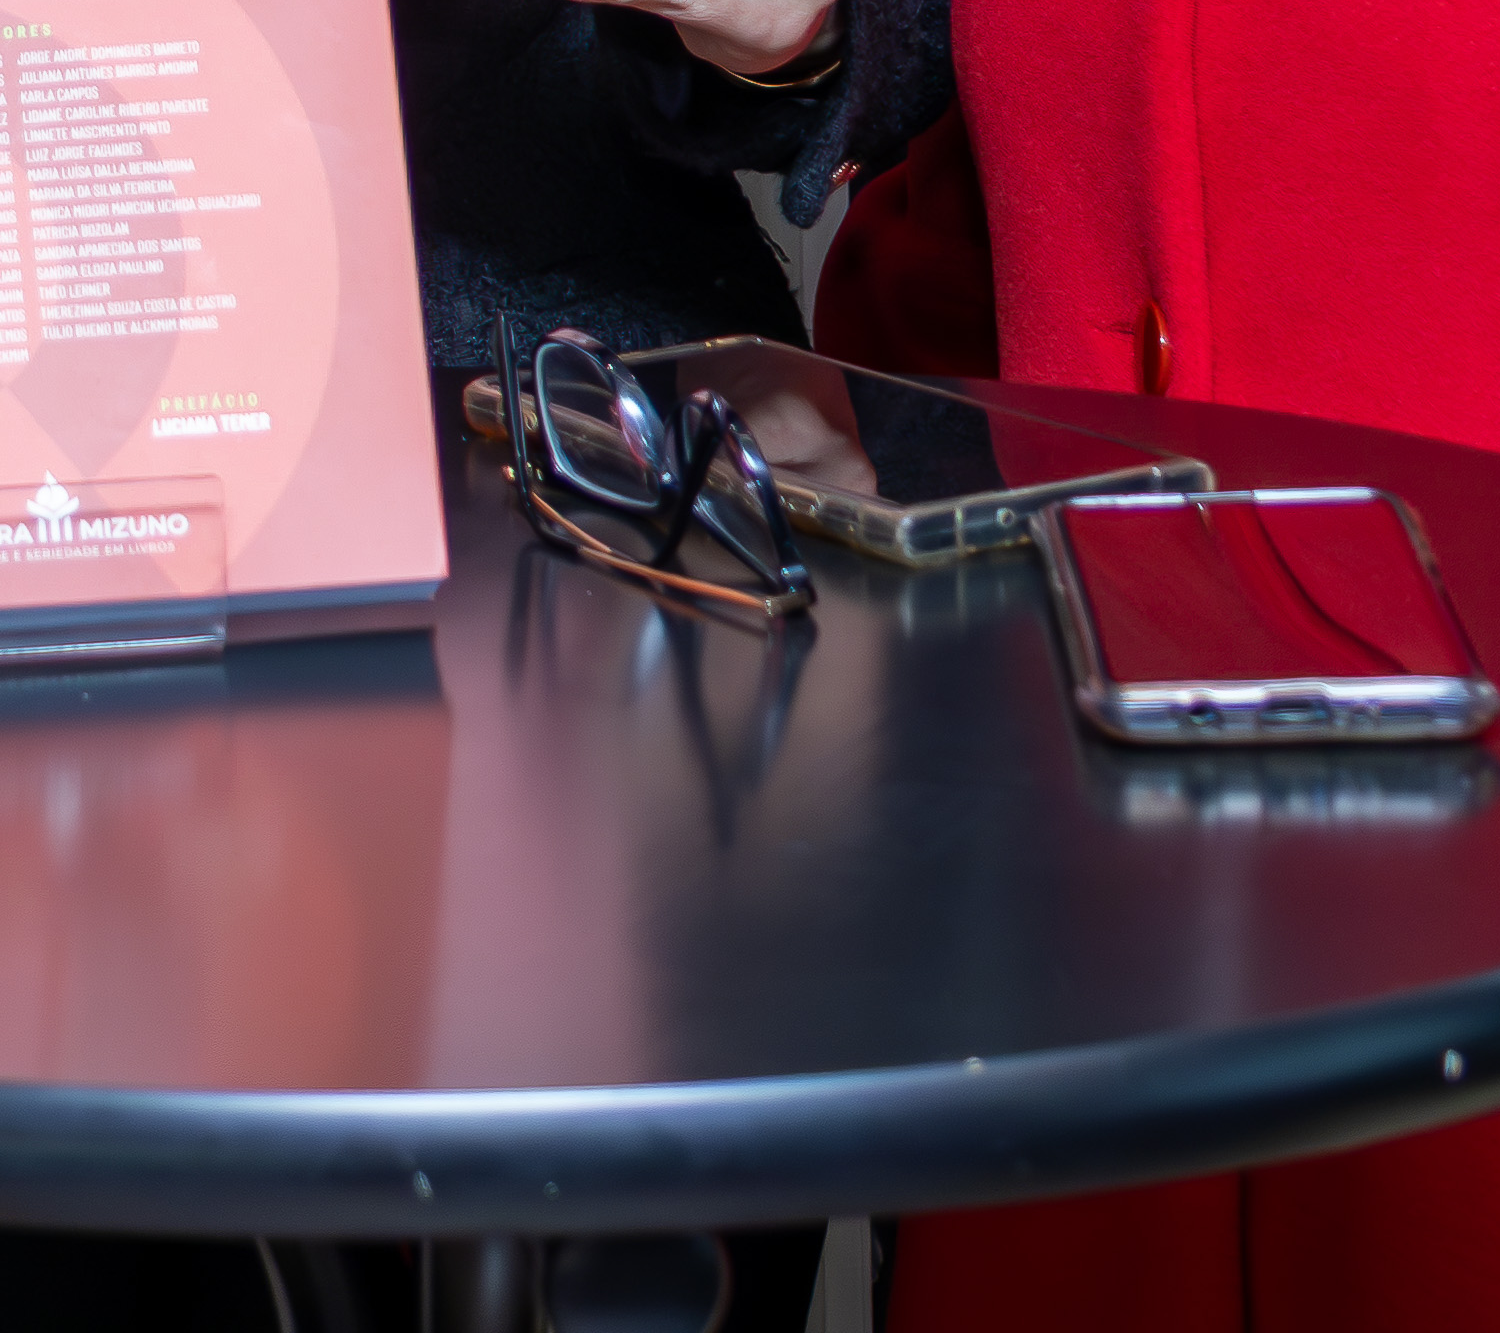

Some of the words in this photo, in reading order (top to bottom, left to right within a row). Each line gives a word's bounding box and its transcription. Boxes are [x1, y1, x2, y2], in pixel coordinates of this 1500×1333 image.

[160, 392, 258, 412] PREFÁCIO
[151, 415, 218, 437] LUCIANA
[219, 411, 270, 432] TEMER
[78, 513, 189, 541] MIZUNO
